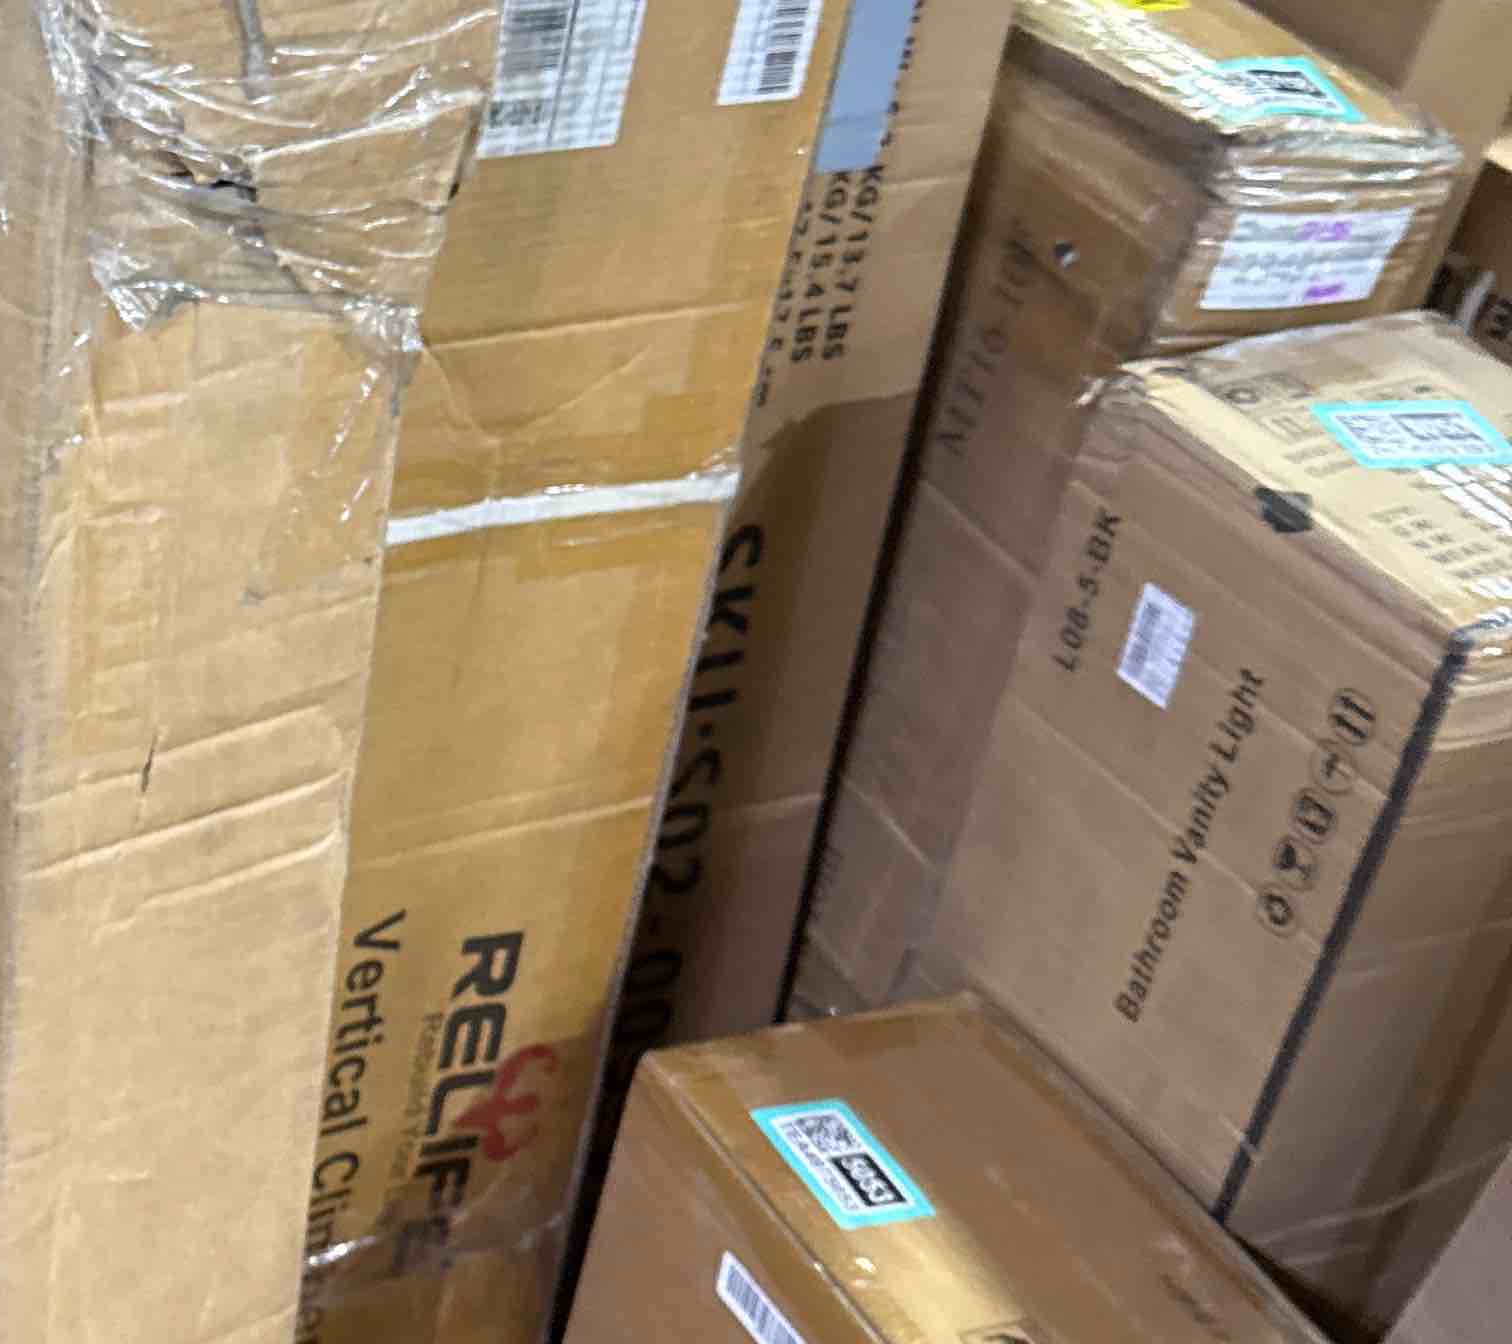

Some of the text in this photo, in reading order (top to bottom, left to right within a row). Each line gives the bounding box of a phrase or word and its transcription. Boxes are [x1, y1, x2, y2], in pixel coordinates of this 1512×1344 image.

[1113, 665, 1265, 1023] Bathroom Vanity Light
[319, 909, 407, 1138] Vertical
